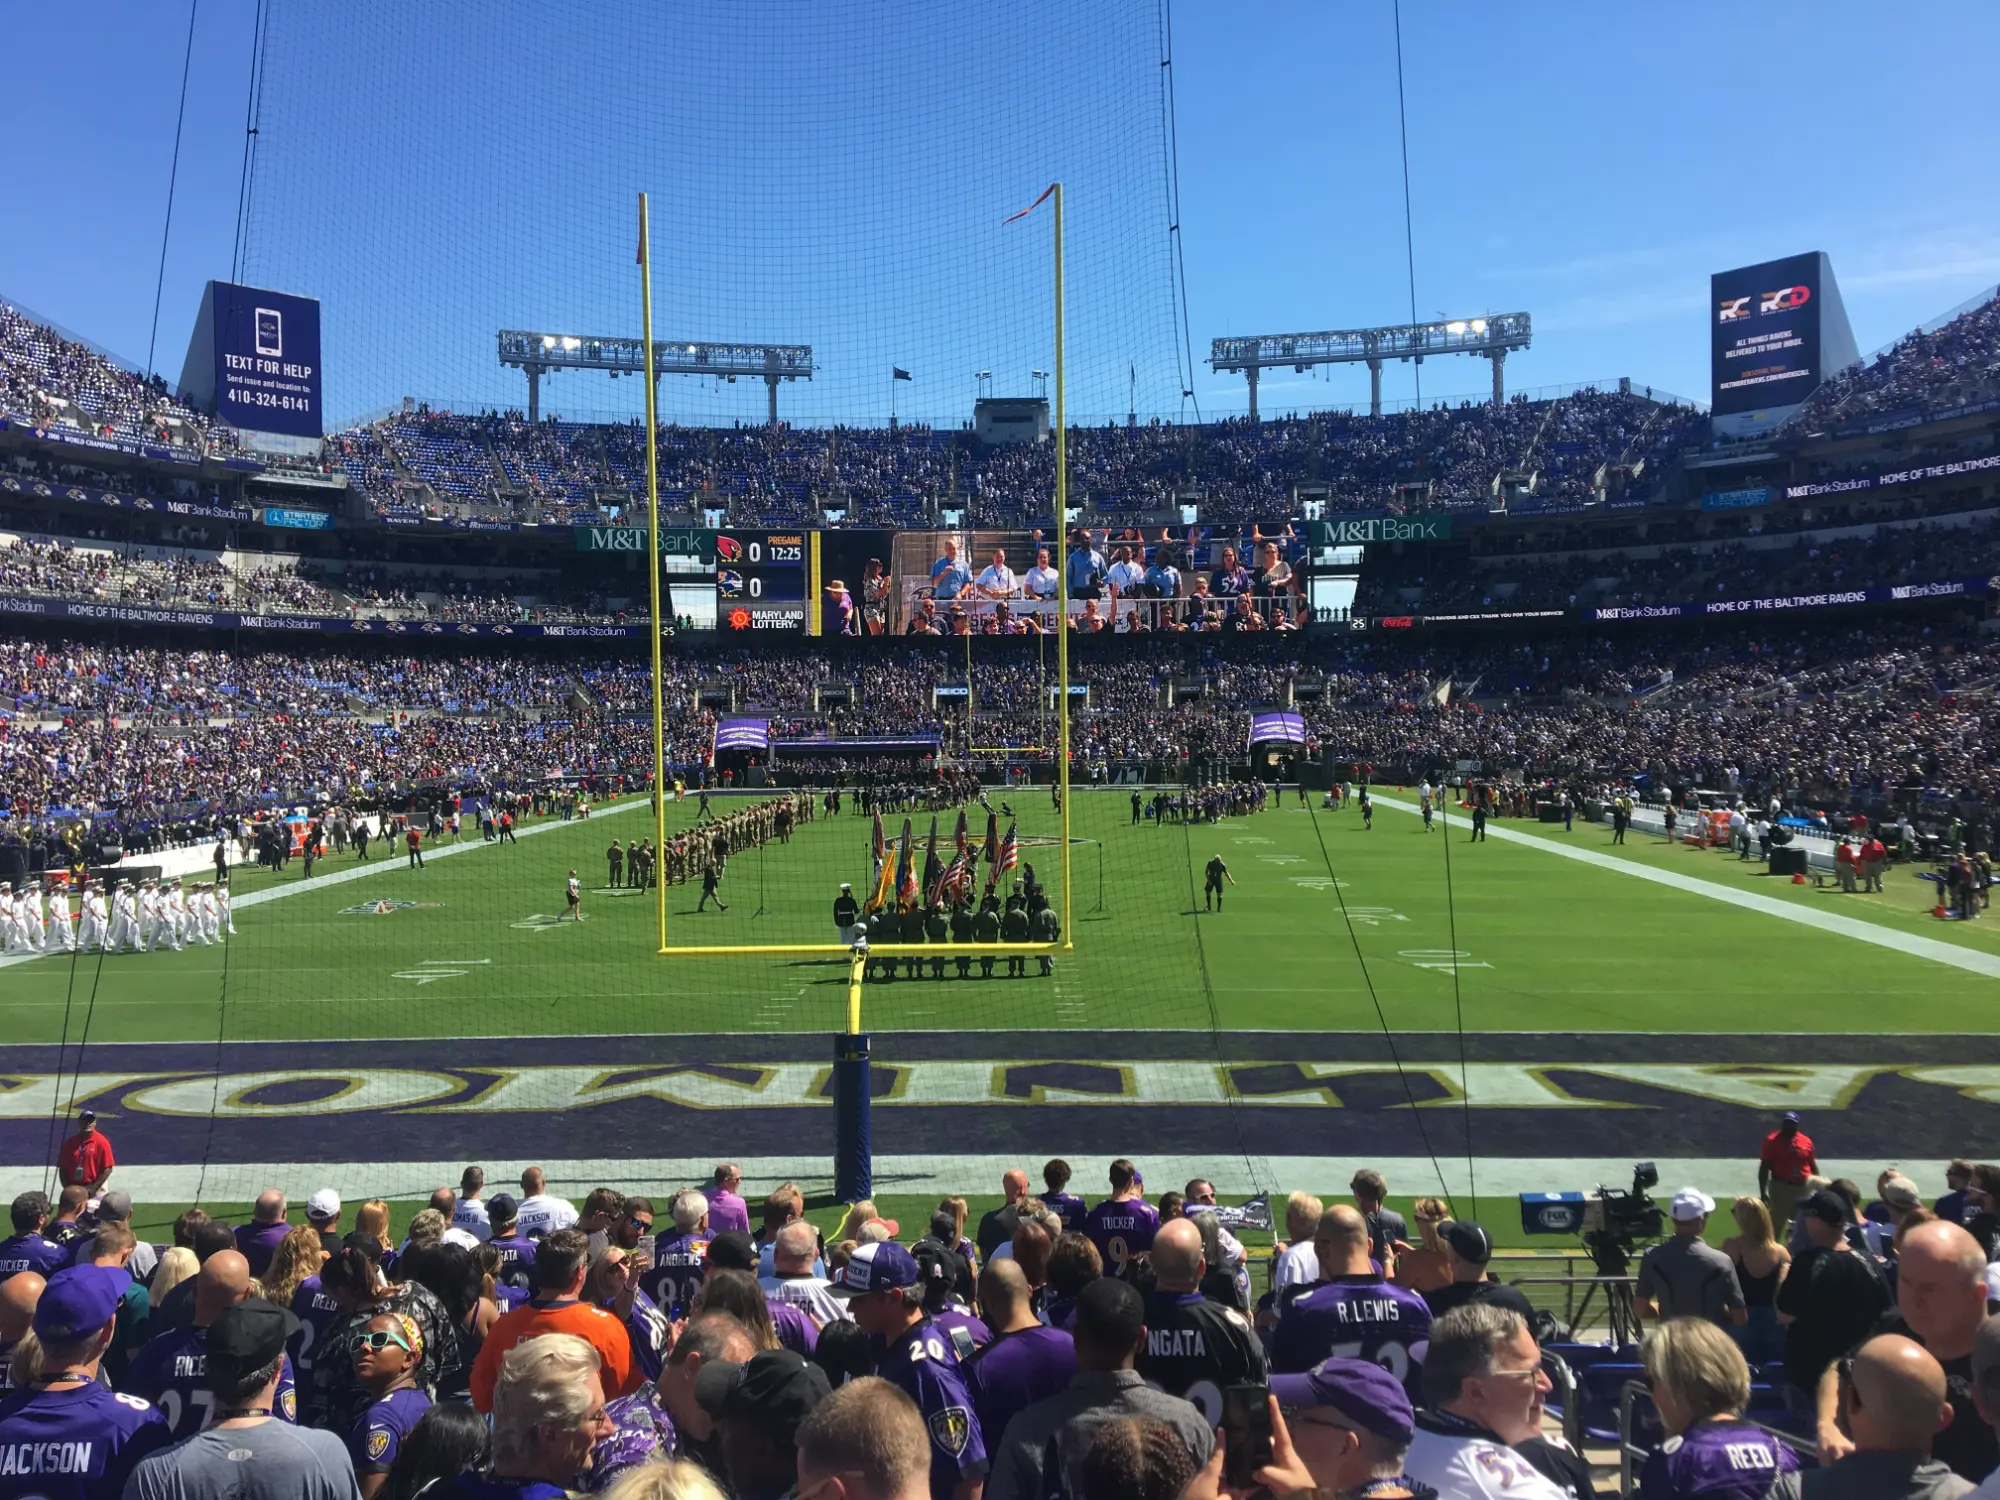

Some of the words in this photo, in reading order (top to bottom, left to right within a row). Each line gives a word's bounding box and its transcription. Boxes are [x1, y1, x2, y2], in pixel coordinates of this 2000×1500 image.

[1736, 338, 1747, 347] ALL
[1748, 334, 1770, 345] THINGS
[1770, 330, 1793, 341] RAVENS
[1725, 346, 1757, 359] DELIVERED
[1758, 344, 1766, 353] TO
[1766, 341, 1783, 352] YOUR
[225, 354, 253, 371] TEXT
[256, 359, 280, 375] FOR
[283, 363, 312, 380] HELP
[226, 373, 243, 384] Send
[245, 376, 262, 386] issue
[263, 379, 275, 388] and
[276, 381, 301, 391] location
[302, 385, 312, 394] to:
[228, 388, 309, 412] 410-324-6141
[64, 436, 85, 446] WORLD
[85, 439, 118, 451] CHAMPIONS
[122, 445, 137, 454] 2012
[1880, 472, 1908, 485] HOME
[1910, 468, 1925, 480] OF
[1925, 465, 1945, 478] THE
[1946, 455, 2000, 474] BALTIMORE
[1787, 486, 1810, 499] M&T
[1810, 483, 1832, 495] Bank
[1832, 478, 1871, 492] Stadium
[167, 501, 190, 515] M&T
[1611, 501, 1645, 509] RAVENS
[282, 518, 328, 529] FACTORY
[283, 511, 329, 522] STRATEGIC
[386, 517, 420, 525] RAVENS
[468, 521, 512, 531] #RavensFlock
[1323, 519, 1381, 543] M&T
[1382, 518, 1437, 540] Bank
[590, 528, 648, 551] M&T
[768, 536, 802, 545] PREGAME
[749, 542, 761, 562] 0
[770, 547, 801, 560] 12:25
[749, 577, 761, 597] 0
[1221, 577, 1238, 593] 52
[1891, 585, 1911, 599] M&T
[1911, 584, 1930, 598] Bank
[1930, 582, 1964, 596] Stadium
[12, 600, 45, 614] Stadium
[1707, 603, 1736, 613] HOME
[1737, 601, 1751, 611] OF
[1753, 599, 1773, 610] THE
[1774, 594, 1828, 609] BALTIMORE
[1829, 591, 1866, 604] RAVENS
[67, 604, 94, 617] HOME
[96, 605, 109, 617] OF
[109, 606, 127, 619] THE
[127, 609, 176, 622] BALTIMORE
[178, 612, 214, 625] RAVENS
[752, 610, 804, 620] MARYLAND
[1596, 608, 1620, 620] M&T
[1621, 607, 1643, 618] Bank
[1643, 605, 1681, 618] Stadium
[240, 615, 263, 627] M&T
[264, 616, 286, 628] Bank
[286, 617, 321, 630] Stadium
[543, 625, 566, 636] M&T
[566, 625, 589, 636] Bank
[589, 625, 626, 636] Stadium
[823, 688, 847, 696] GEICO
[937, 686, 968, 695] GEICO
[1054, 686, 1086, 694] GCO
[519, 1211, 551, 1226] JACKSON
[1102, 1216, 1135, 1231] TUCKER
[1549, 1210, 1570, 1222] FOX
[56, 1228, 75, 1246] 52
[660, 1253, 702, 1267] ANDREWS
[1108, 1236, 1129, 1277] 9
[0, 1259, 30, 1272] UCKER
[312, 1293, 338, 1312] REED
[1337, 1300, 1400, 1323] R.LEWIS
[909, 1338, 945, 1362] 20
[1149, 1329, 1206, 1357] NGATA
[175, 1355, 206, 1377] RICE
[115, 1392, 150, 1411] 8
[1725, 1442, 1775, 1470] REED
